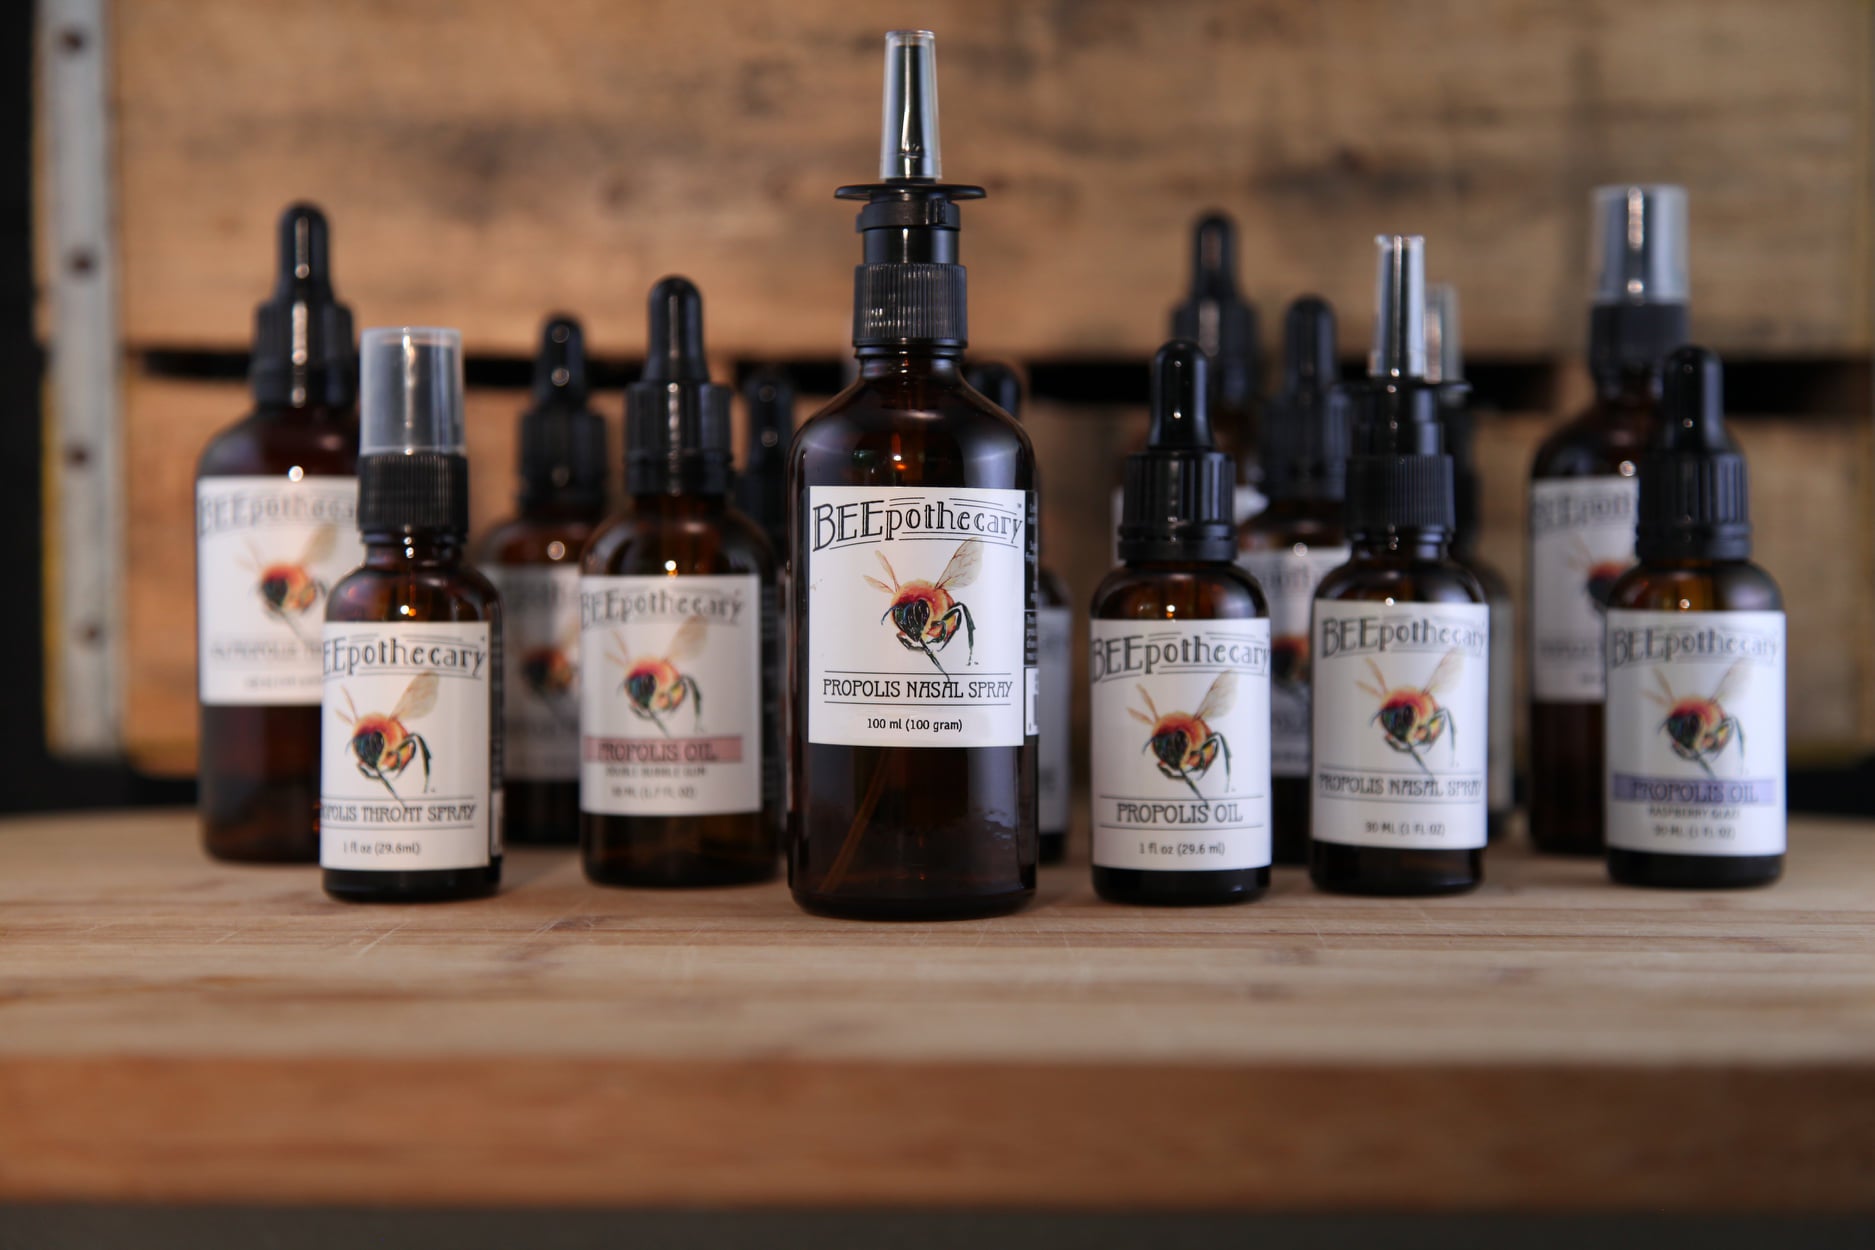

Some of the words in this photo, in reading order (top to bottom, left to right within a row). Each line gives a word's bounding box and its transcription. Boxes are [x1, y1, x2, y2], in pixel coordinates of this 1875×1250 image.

[812, 499, 1024, 552] BEEpothecary
[1322, 617, 1485, 658] BEEpothecary
[323, 636, 486, 676] EEpothecary
[823, 678, 901, 698] PROPOLIS
[906, 679, 964, 699] NASAL
[968, 681, 1013, 699] SPRAY
[867, 718, 886, 730] 100
[889, 718, 902, 730] ml
[905, 718, 930, 732] (100
[933, 719, 963, 732] gram)
[1320, 773, 1384, 795] PROPOLIS
[1389, 778, 1444, 797] NASAL
[1633, 781, 1724, 803] PROPOLIS
[1729, 783, 1759, 803] OIL
[361, 806, 423, 823] THROAT
[427, 804, 476, 822] SPRAY
[1116, 803, 1208, 824] PROPOLIS
[1214, 803, 1243, 823] OIL
